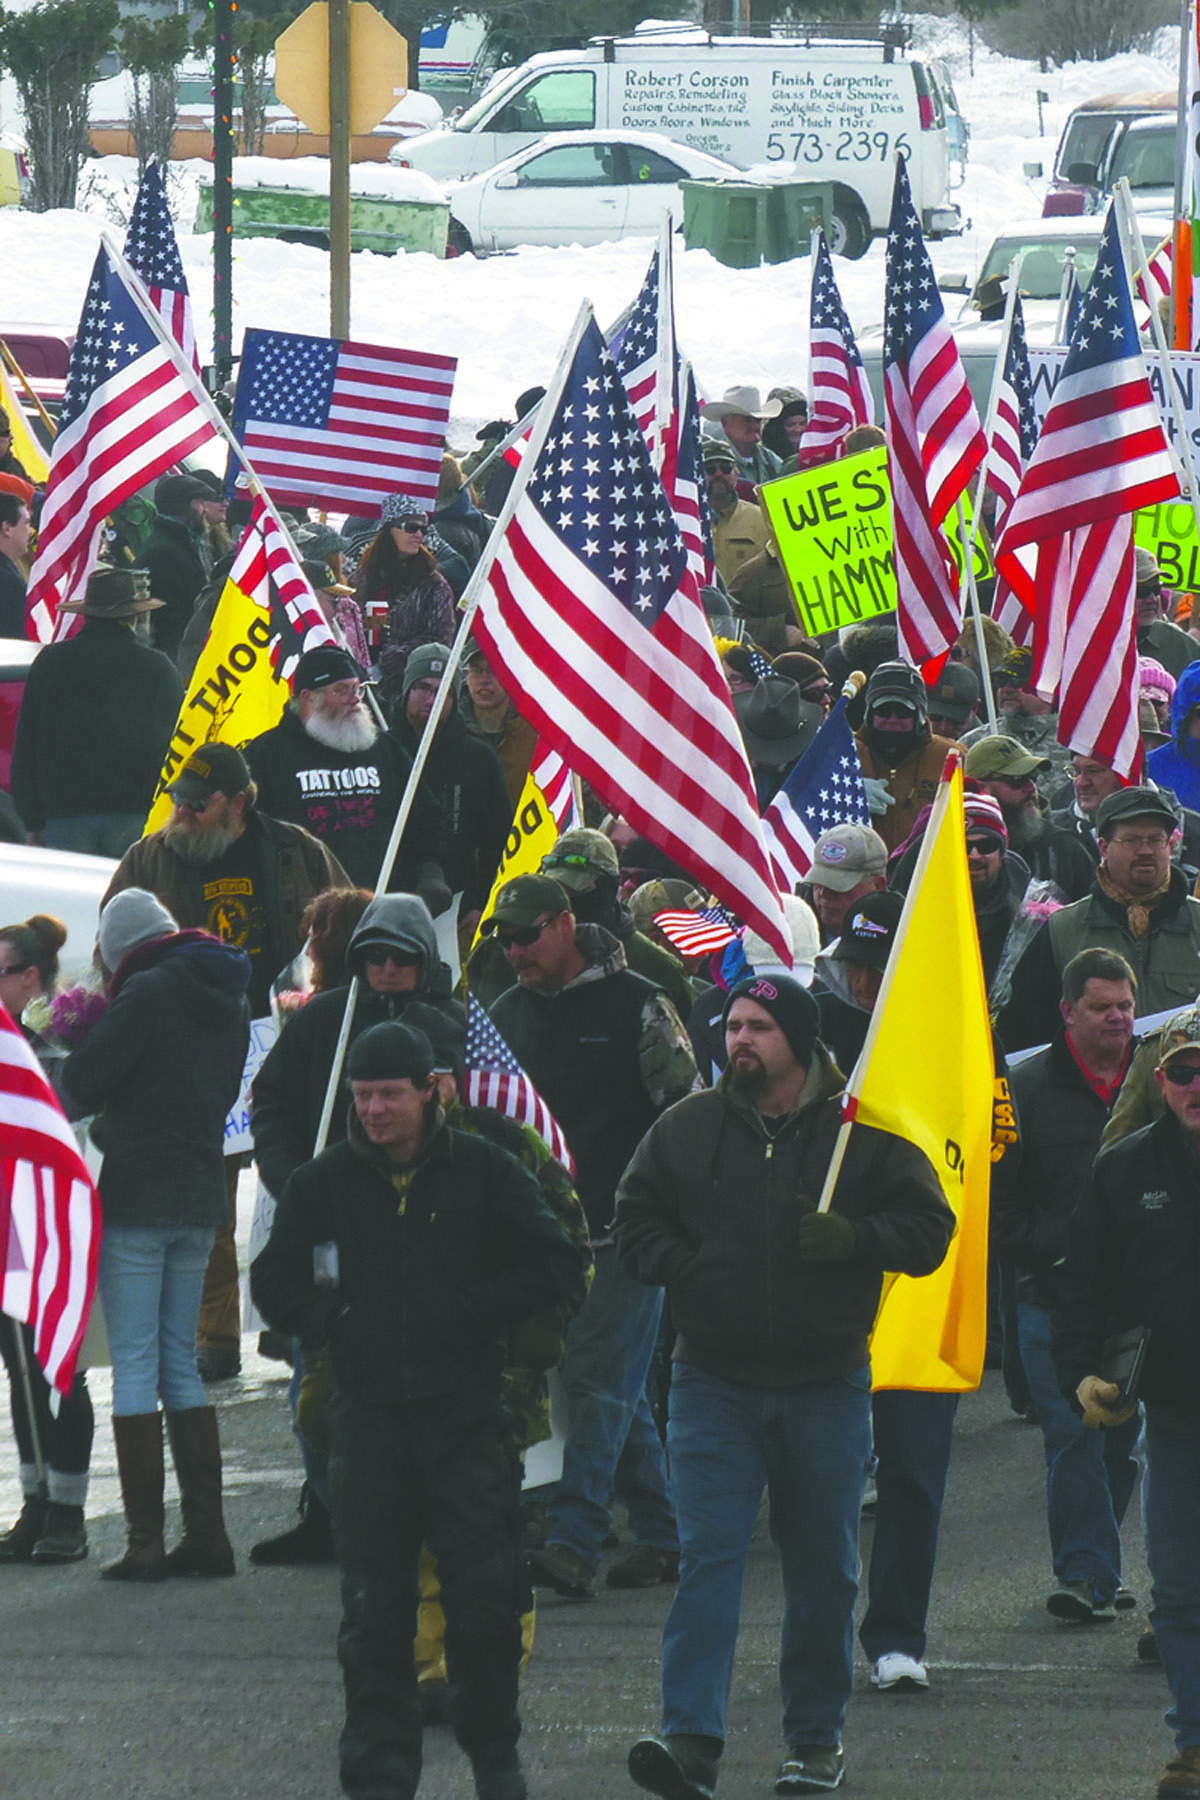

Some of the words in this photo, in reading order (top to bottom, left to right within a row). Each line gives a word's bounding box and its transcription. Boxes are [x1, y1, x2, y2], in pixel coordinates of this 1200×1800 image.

[625, 69, 683, 86] Robert
[689, 71, 750, 87] Corson
[772, 70, 814, 86] Finish
[823, 73, 893, 90] Carpenter
[772, 90, 804, 100] Glass
[810, 89, 842, 100] Block
[622, 103, 663, 113] Custom
[770, 117, 794, 127] and
[800, 117, 832, 128] Much
[766, 131, 912, 162] 573-2396
[782, 481, 848, 531] WE
[296, 766, 381, 792] TATTOOS
[356, 788, 381, 796] WORLD
[749, 979, 778, 1000] P
